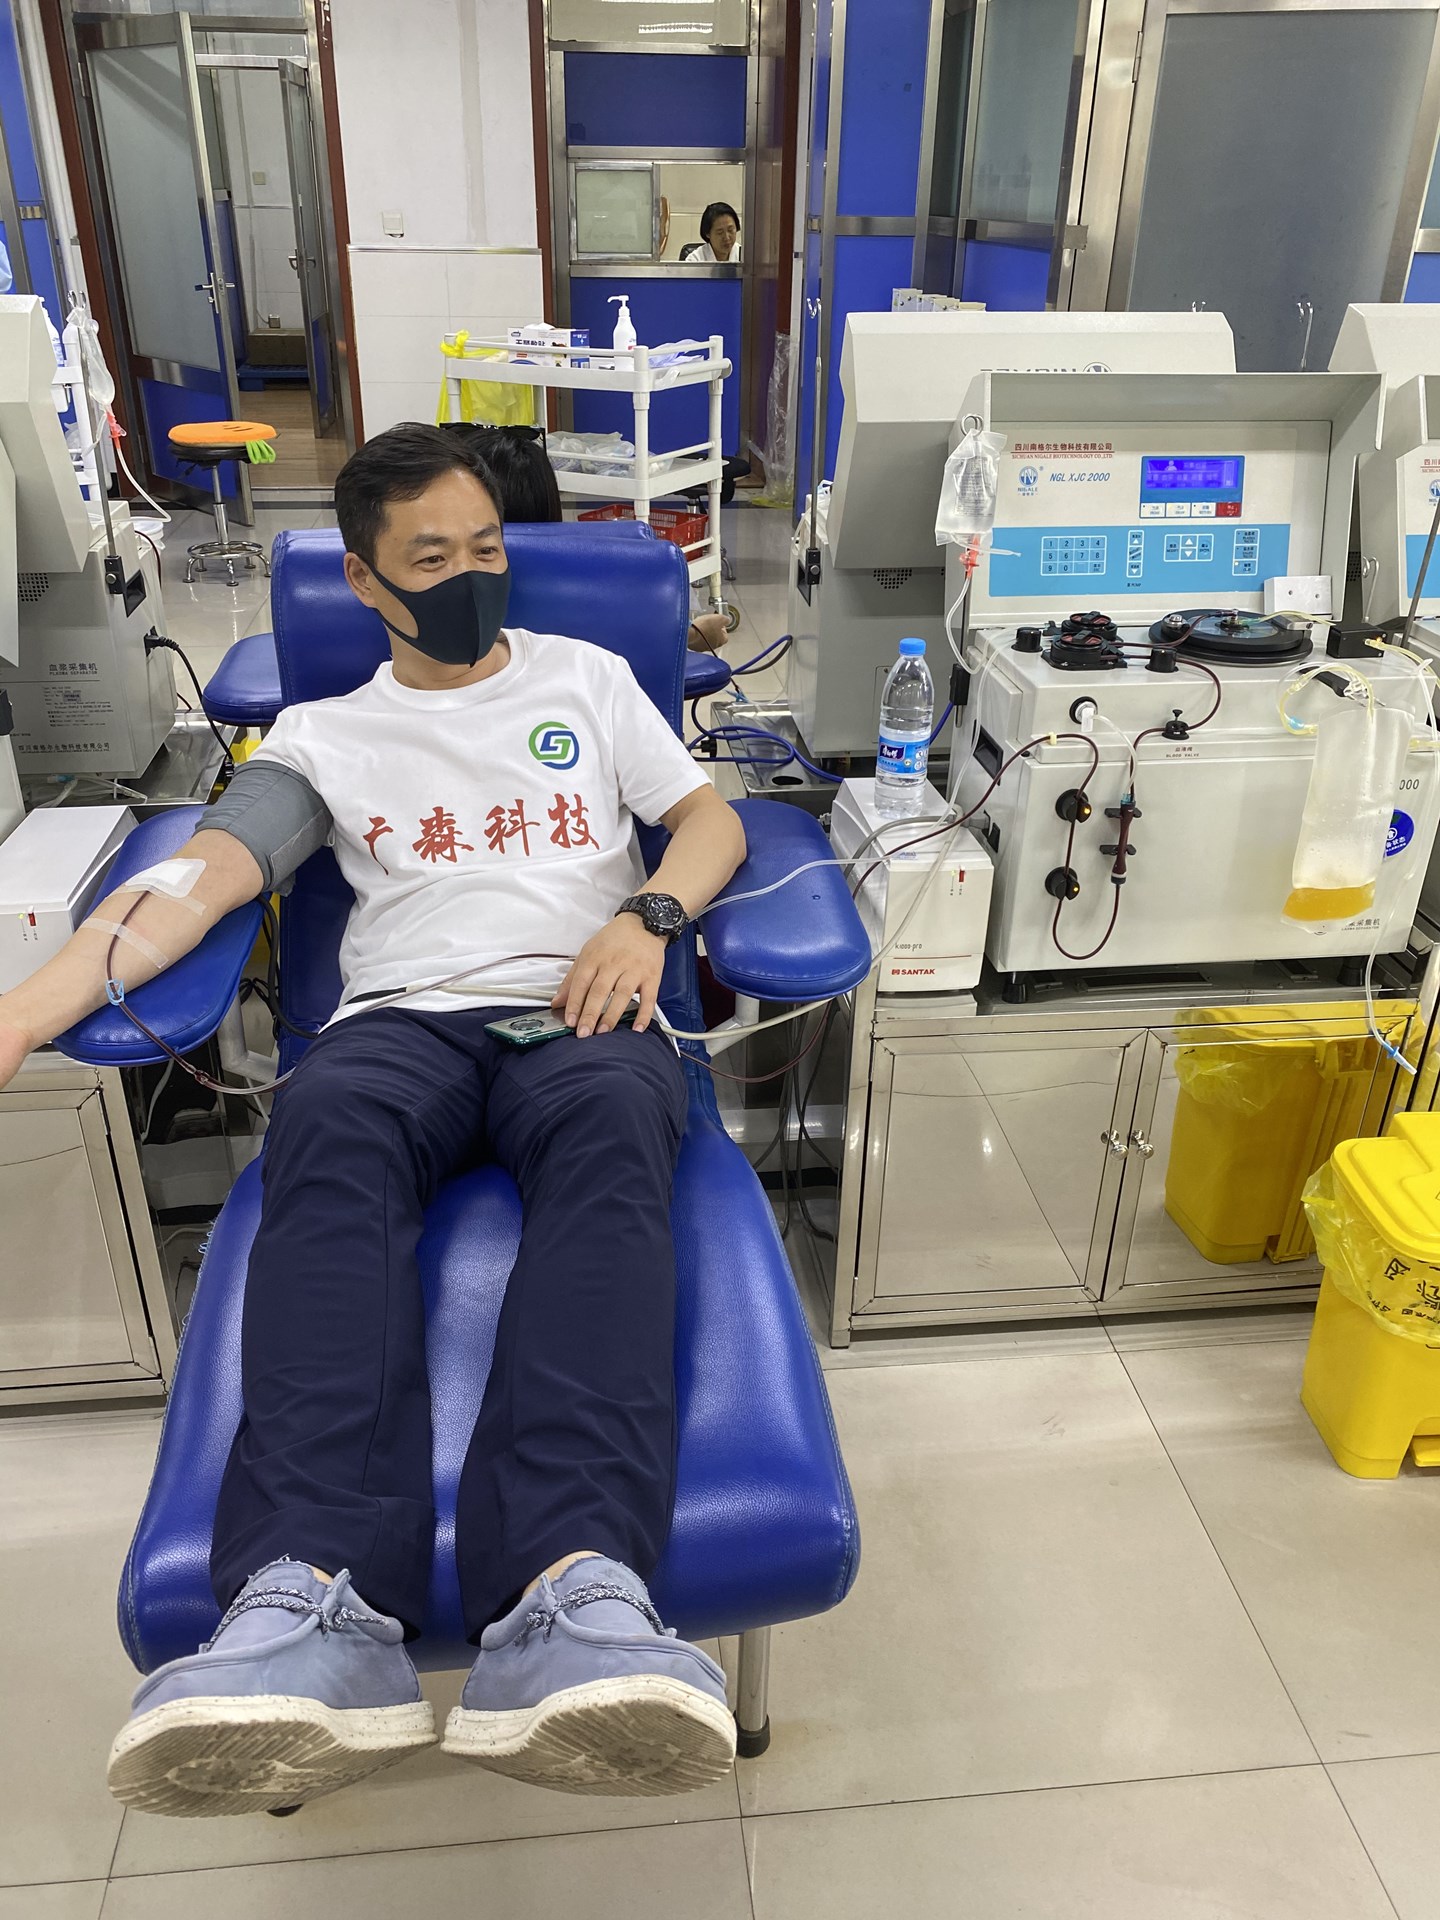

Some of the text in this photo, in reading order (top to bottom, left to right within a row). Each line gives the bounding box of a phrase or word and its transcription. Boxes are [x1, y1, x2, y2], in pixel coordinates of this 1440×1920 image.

[1050, 473, 1111, 481] NGL XJC 2000
